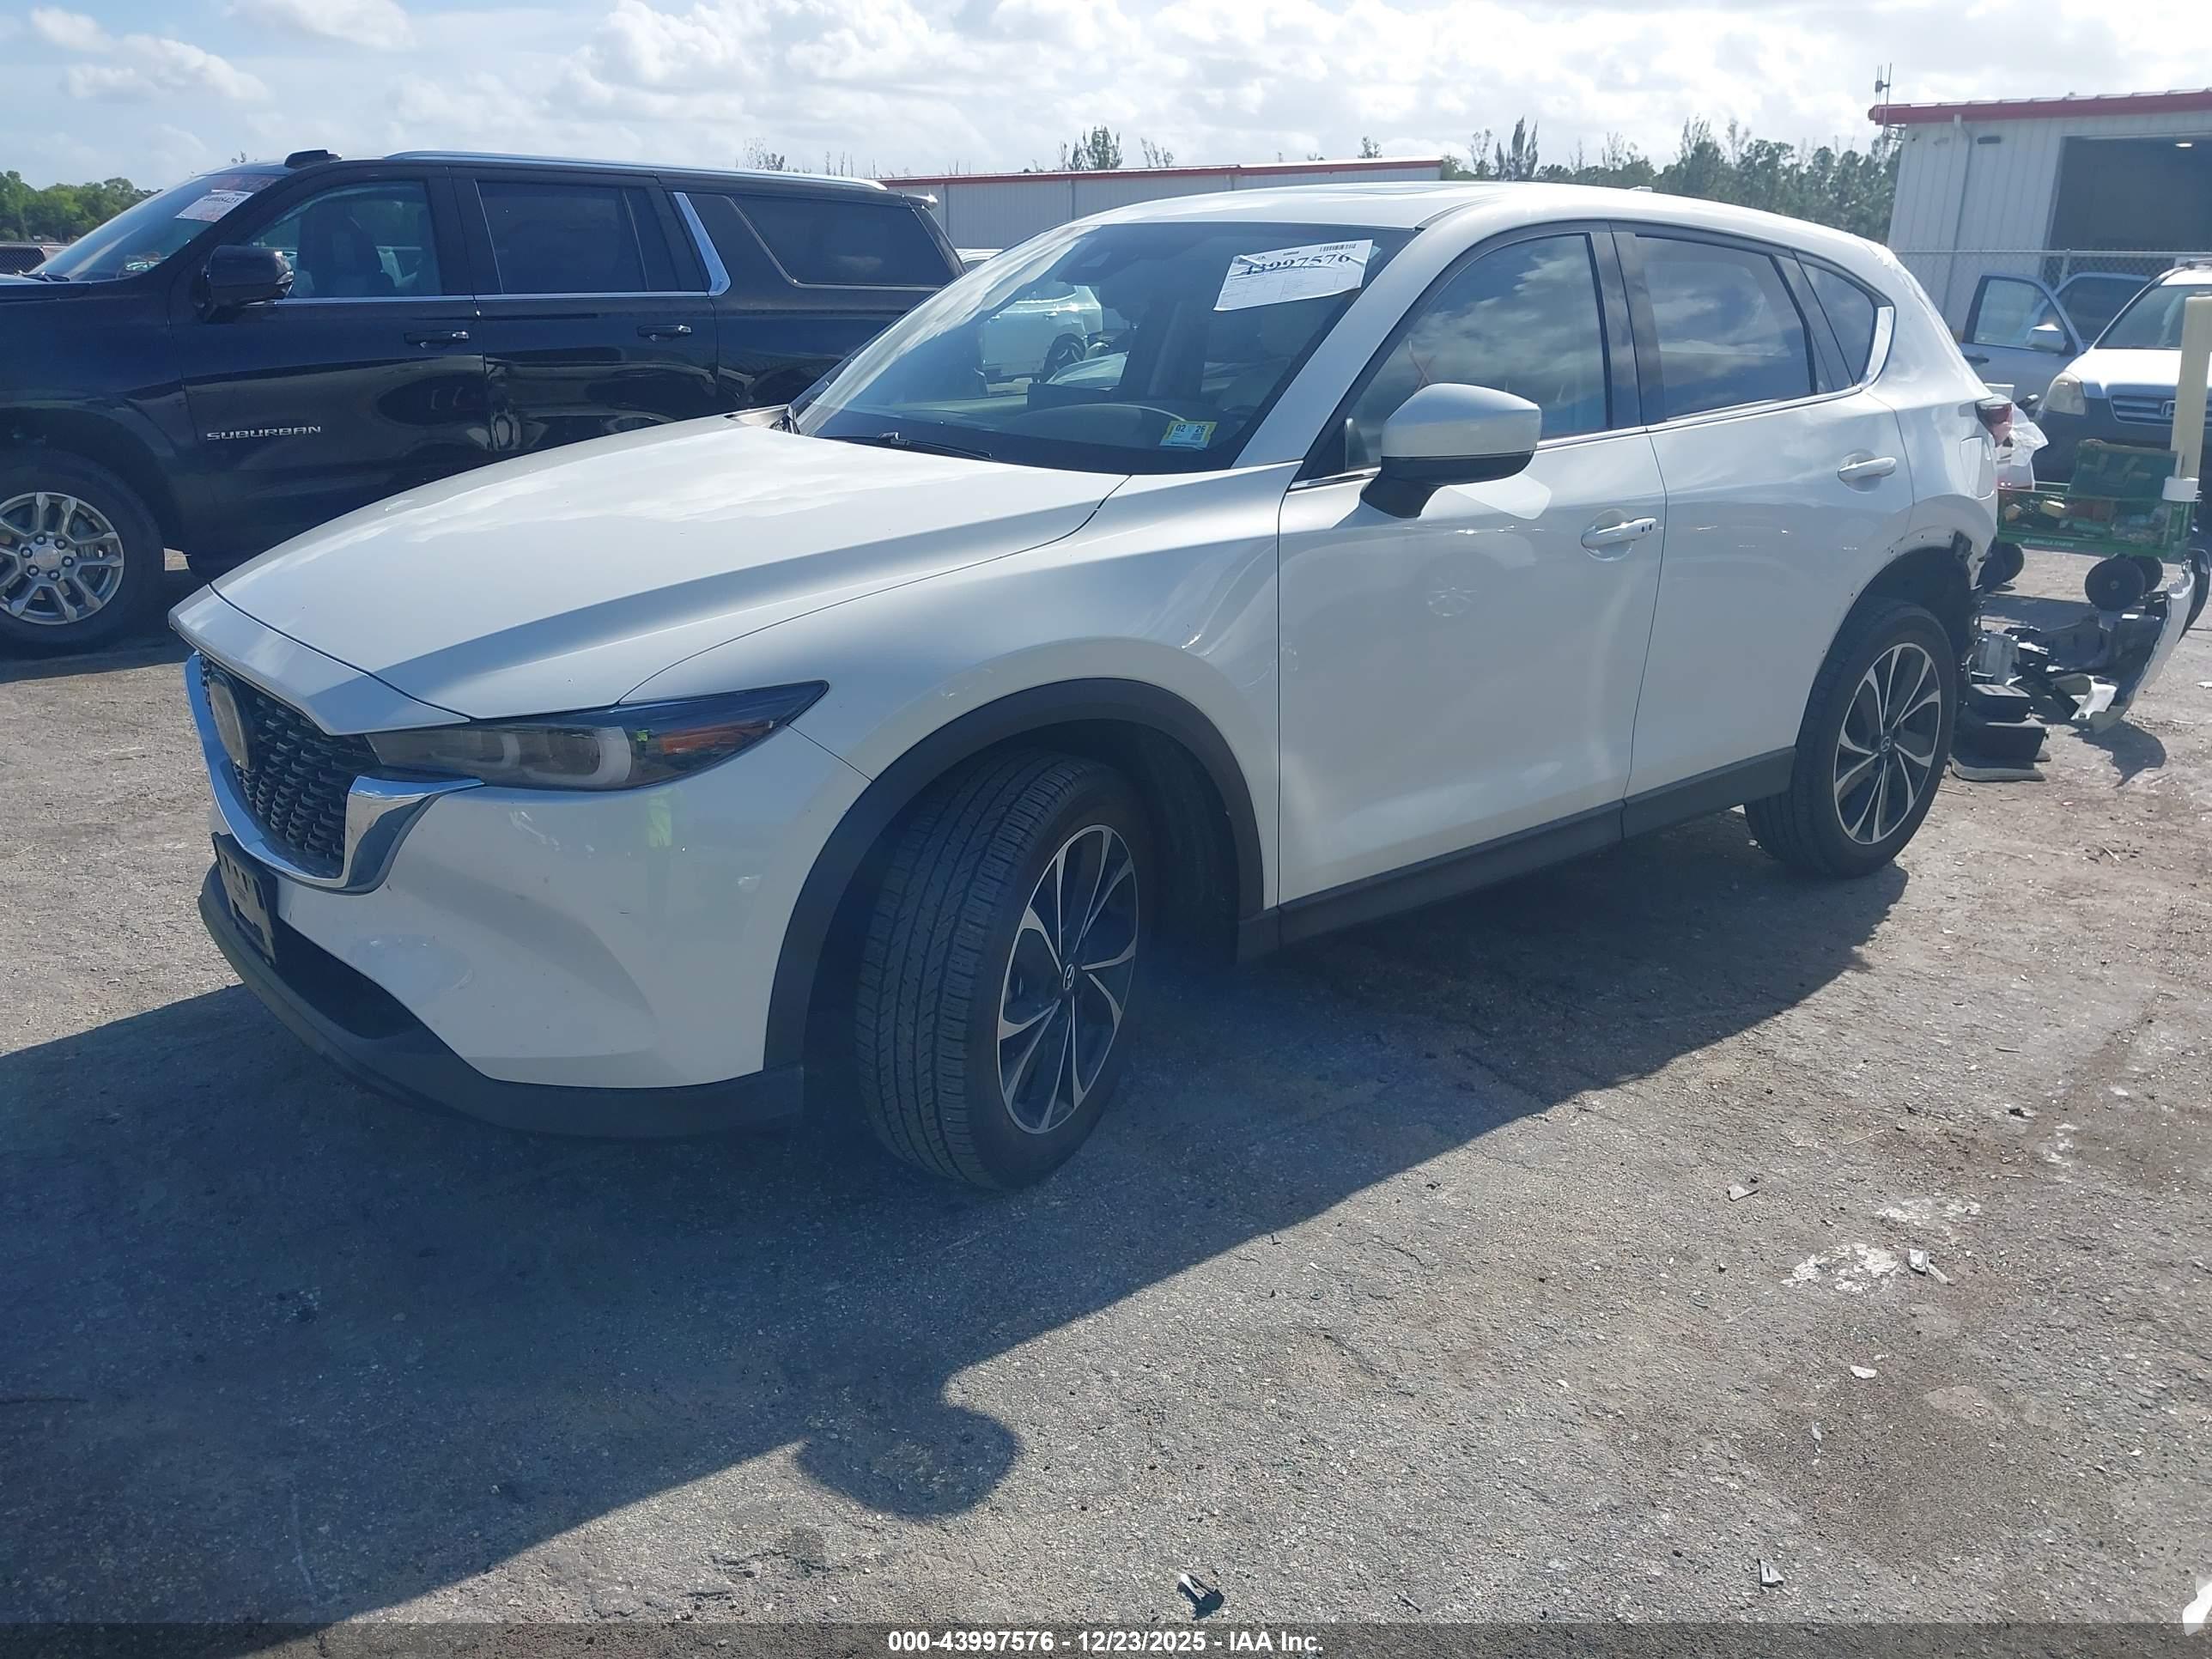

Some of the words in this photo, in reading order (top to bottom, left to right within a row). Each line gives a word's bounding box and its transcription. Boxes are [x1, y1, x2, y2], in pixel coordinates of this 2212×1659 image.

[206, 426, 321, 441] SUBURBAN
[1176, 424, 1187, 433] 02
[1194, 425, 1206, 434] 26
